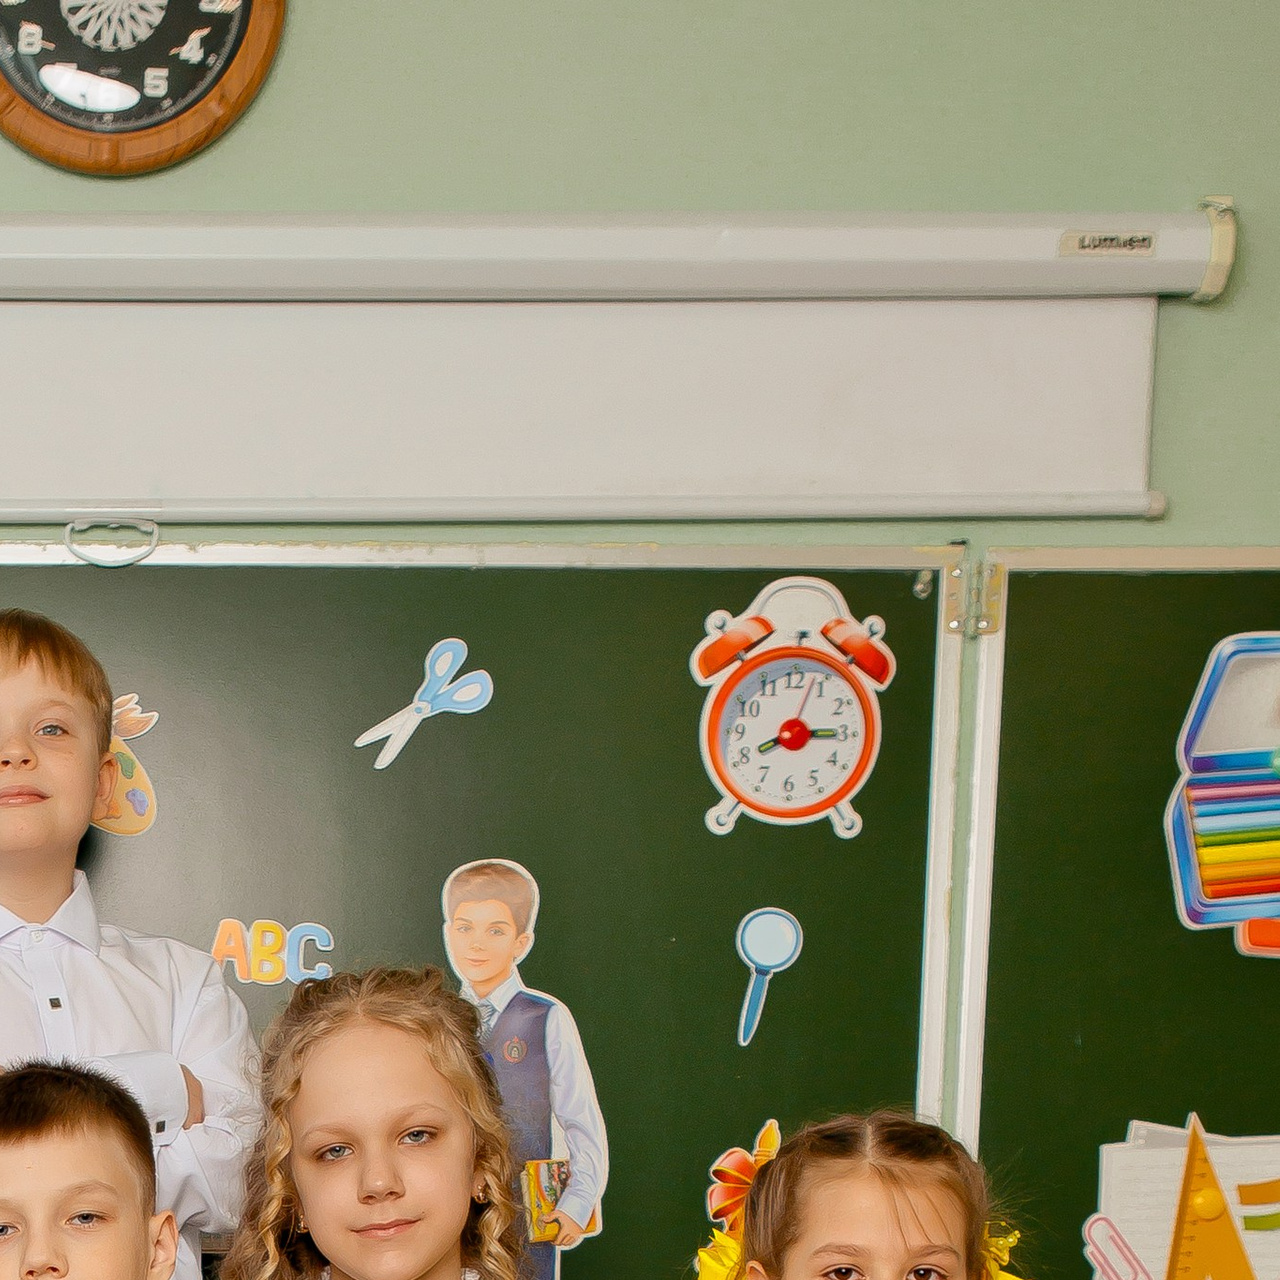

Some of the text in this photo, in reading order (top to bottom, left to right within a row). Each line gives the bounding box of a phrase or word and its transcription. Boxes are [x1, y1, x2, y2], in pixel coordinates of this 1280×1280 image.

[143, 67, 169, 97] 5
[761, 678, 778, 696] 11
[785, 671, 804, 689] 12
[817, 681, 825, 697] 1
[740, 702, 760, 717] 10
[832, 698, 844, 715] 2
[735, 724, 745, 740] 9
[838, 724, 848, 741] 3
[740, 747, 750, 764] 8
[826, 751, 838, 767] 4
[759, 766, 770, 783] 7
[808, 769, 819, 786] 5
[784, 775, 794, 792] 6
[213, 920, 331, 982] ABC
